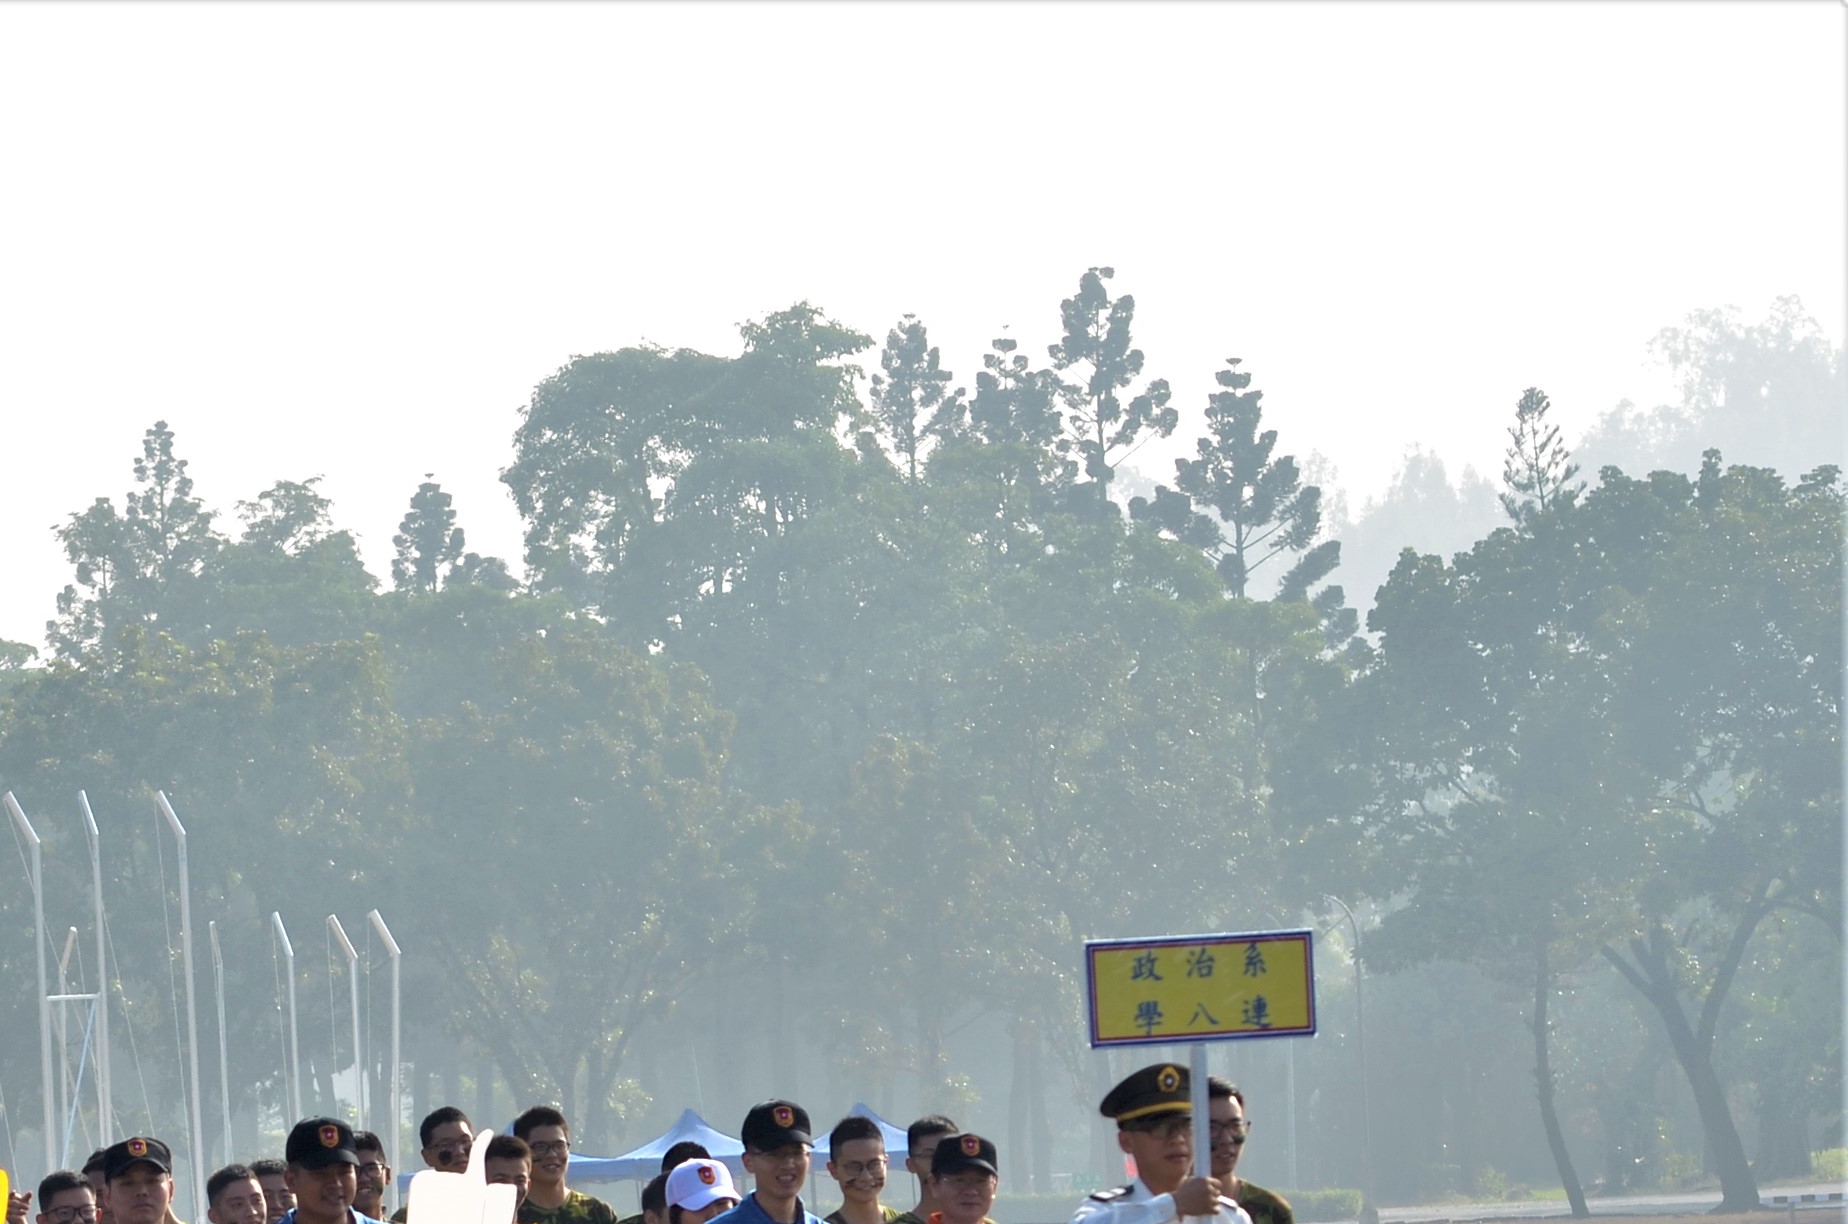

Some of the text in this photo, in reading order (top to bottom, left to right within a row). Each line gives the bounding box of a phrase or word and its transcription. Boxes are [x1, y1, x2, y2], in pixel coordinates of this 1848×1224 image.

[1130, 941, 1267, 982] 政治系
[1134, 994, 1272, 1035] 學八連
